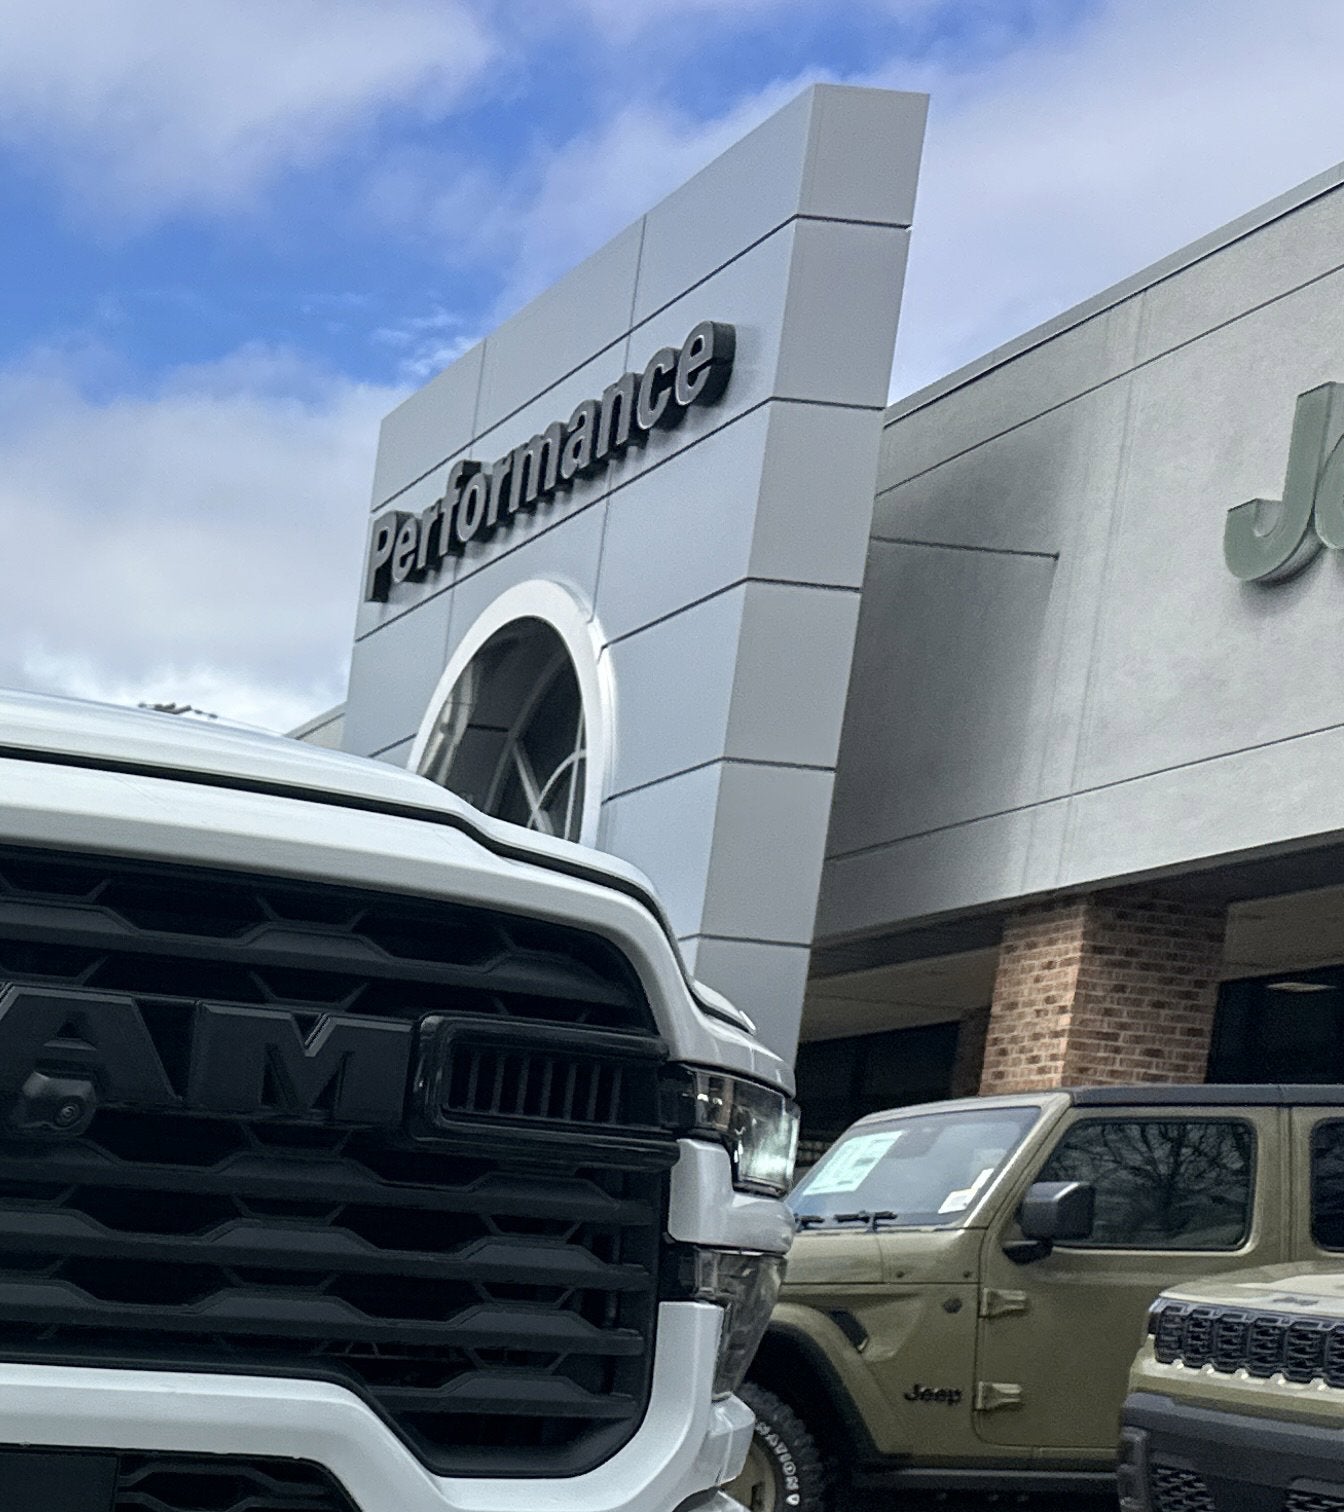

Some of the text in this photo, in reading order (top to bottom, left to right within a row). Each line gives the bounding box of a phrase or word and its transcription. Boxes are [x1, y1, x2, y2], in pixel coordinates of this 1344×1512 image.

[365, 320, 736, 602] Performance
[1224, 381, 1344, 581] J
[903, 1384, 962, 1406] Jeep
